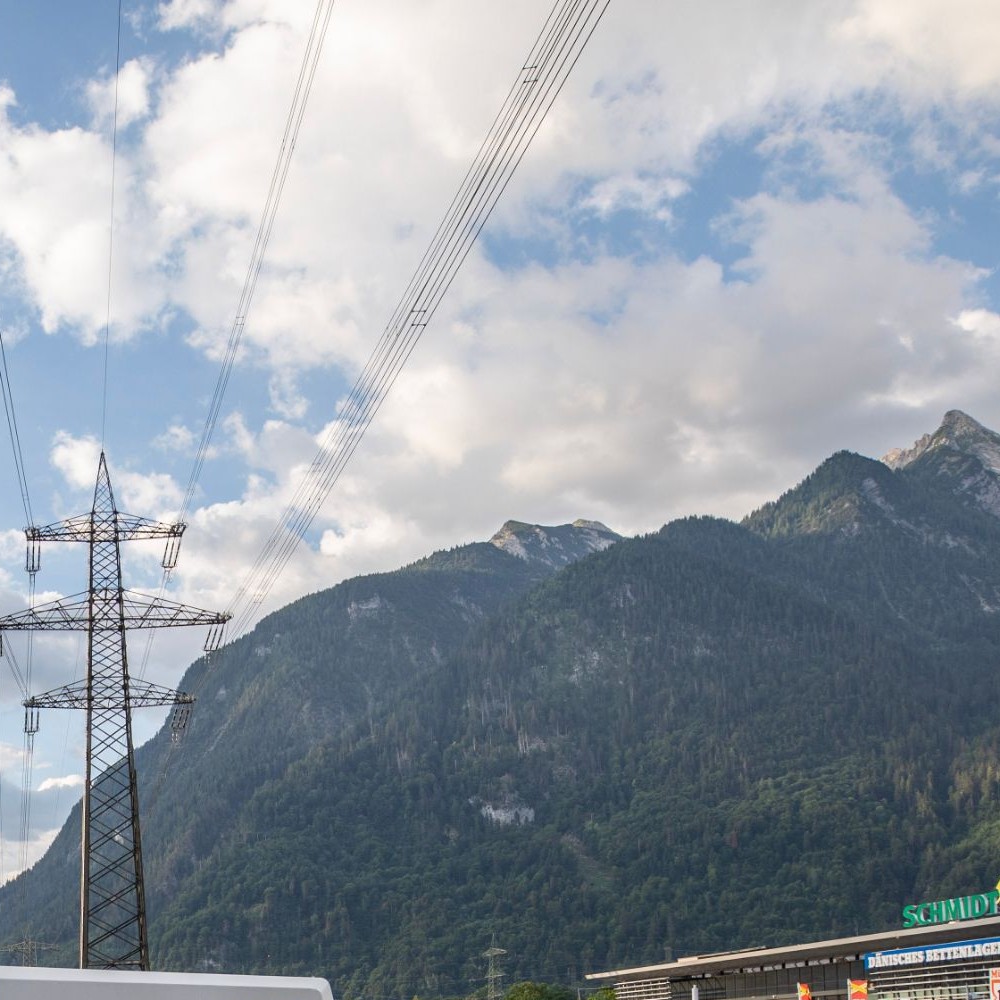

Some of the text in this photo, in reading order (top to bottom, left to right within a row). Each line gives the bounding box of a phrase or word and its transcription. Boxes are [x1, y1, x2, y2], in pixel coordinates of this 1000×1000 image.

[903, 890, 998, 928] SCHMIDT
[868, 942, 1000, 969] DÄNISCHES BETTENLAGE
